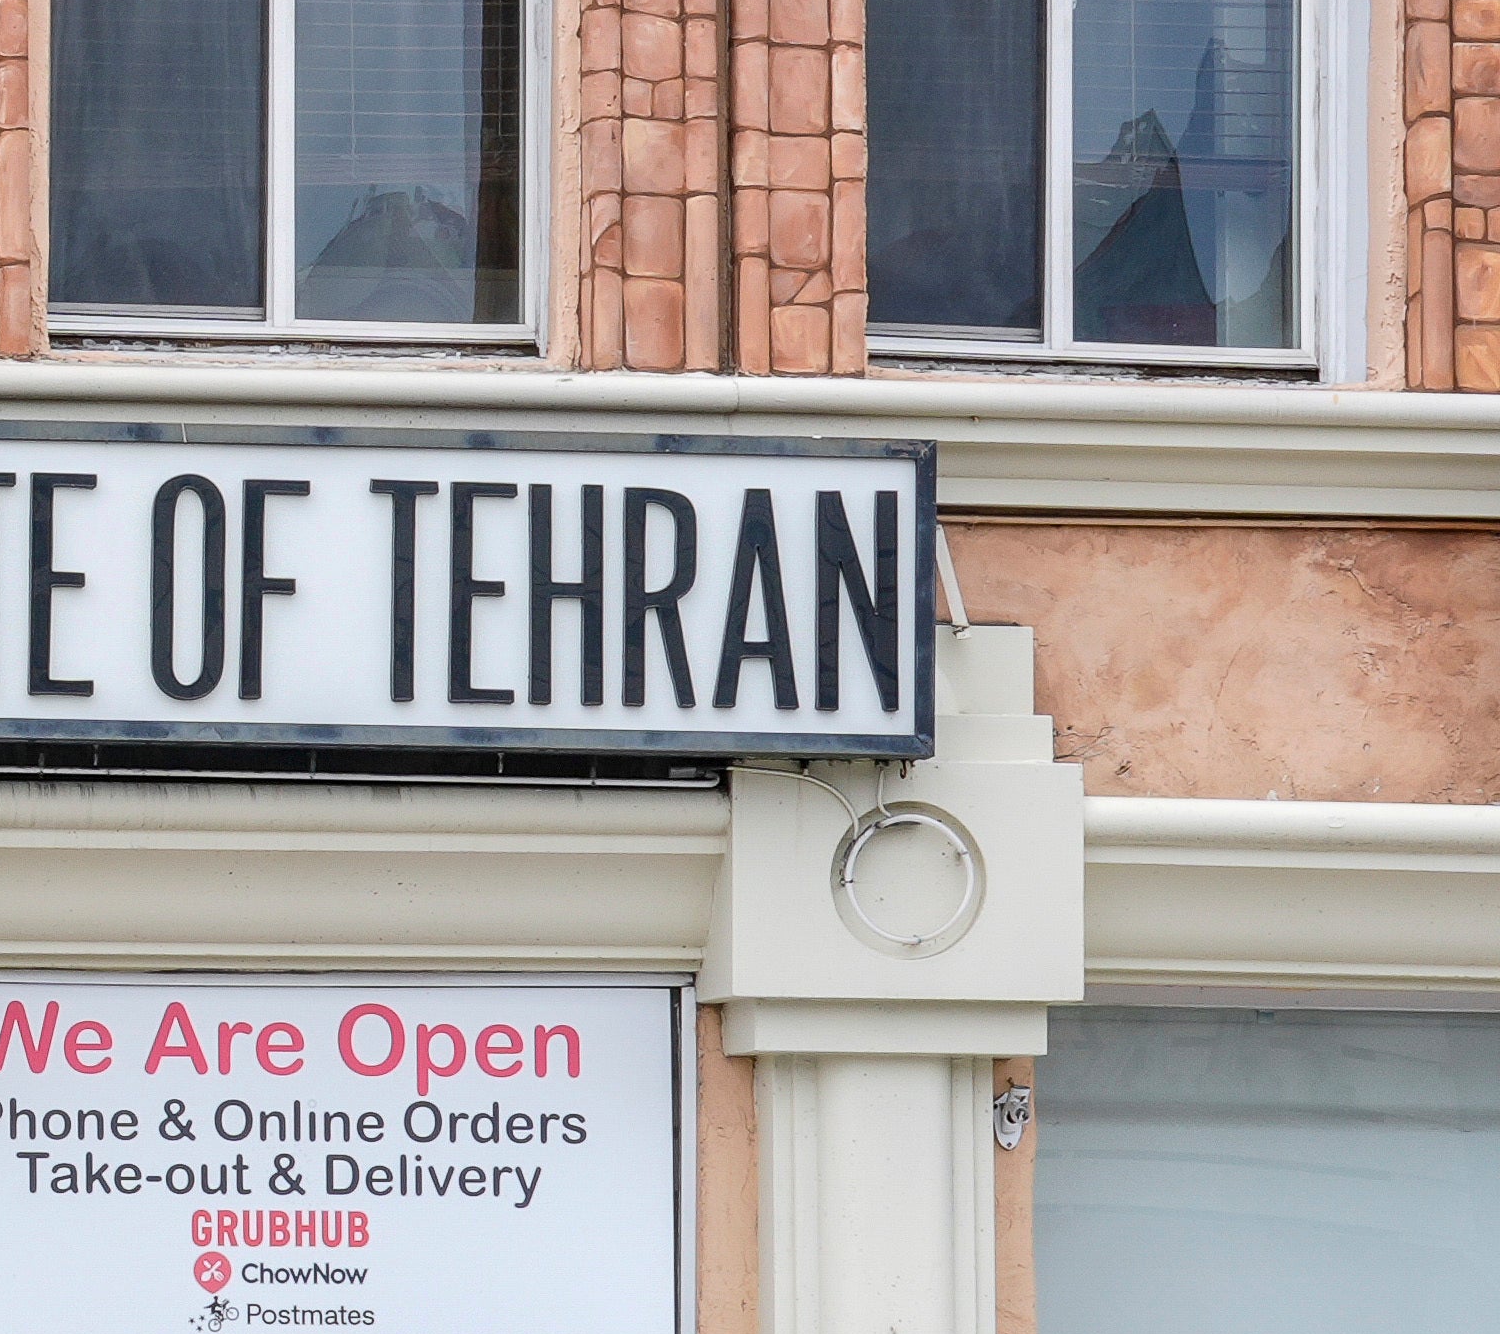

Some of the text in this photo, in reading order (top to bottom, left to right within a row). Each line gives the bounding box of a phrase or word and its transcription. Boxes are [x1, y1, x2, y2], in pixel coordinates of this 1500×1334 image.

[149, 473, 311, 703] OF
[369, 477, 899, 713] TEHRAN
[145, 1001, 305, 1076] Are
[337, 1003, 581, 1096] Open
[159, 1099, 195, 1141] &
[214, 1100, 384, 1143] Online
[404, 1101, 588, 1145] Orders
[17, 1152, 542, 1209] Take-out & Delivery
[191, 1209, 370, 1248] GRUBHUB
[241, 1262, 368, 1285] ChowNow
[246, 1303, 375, 1326] Postmates
